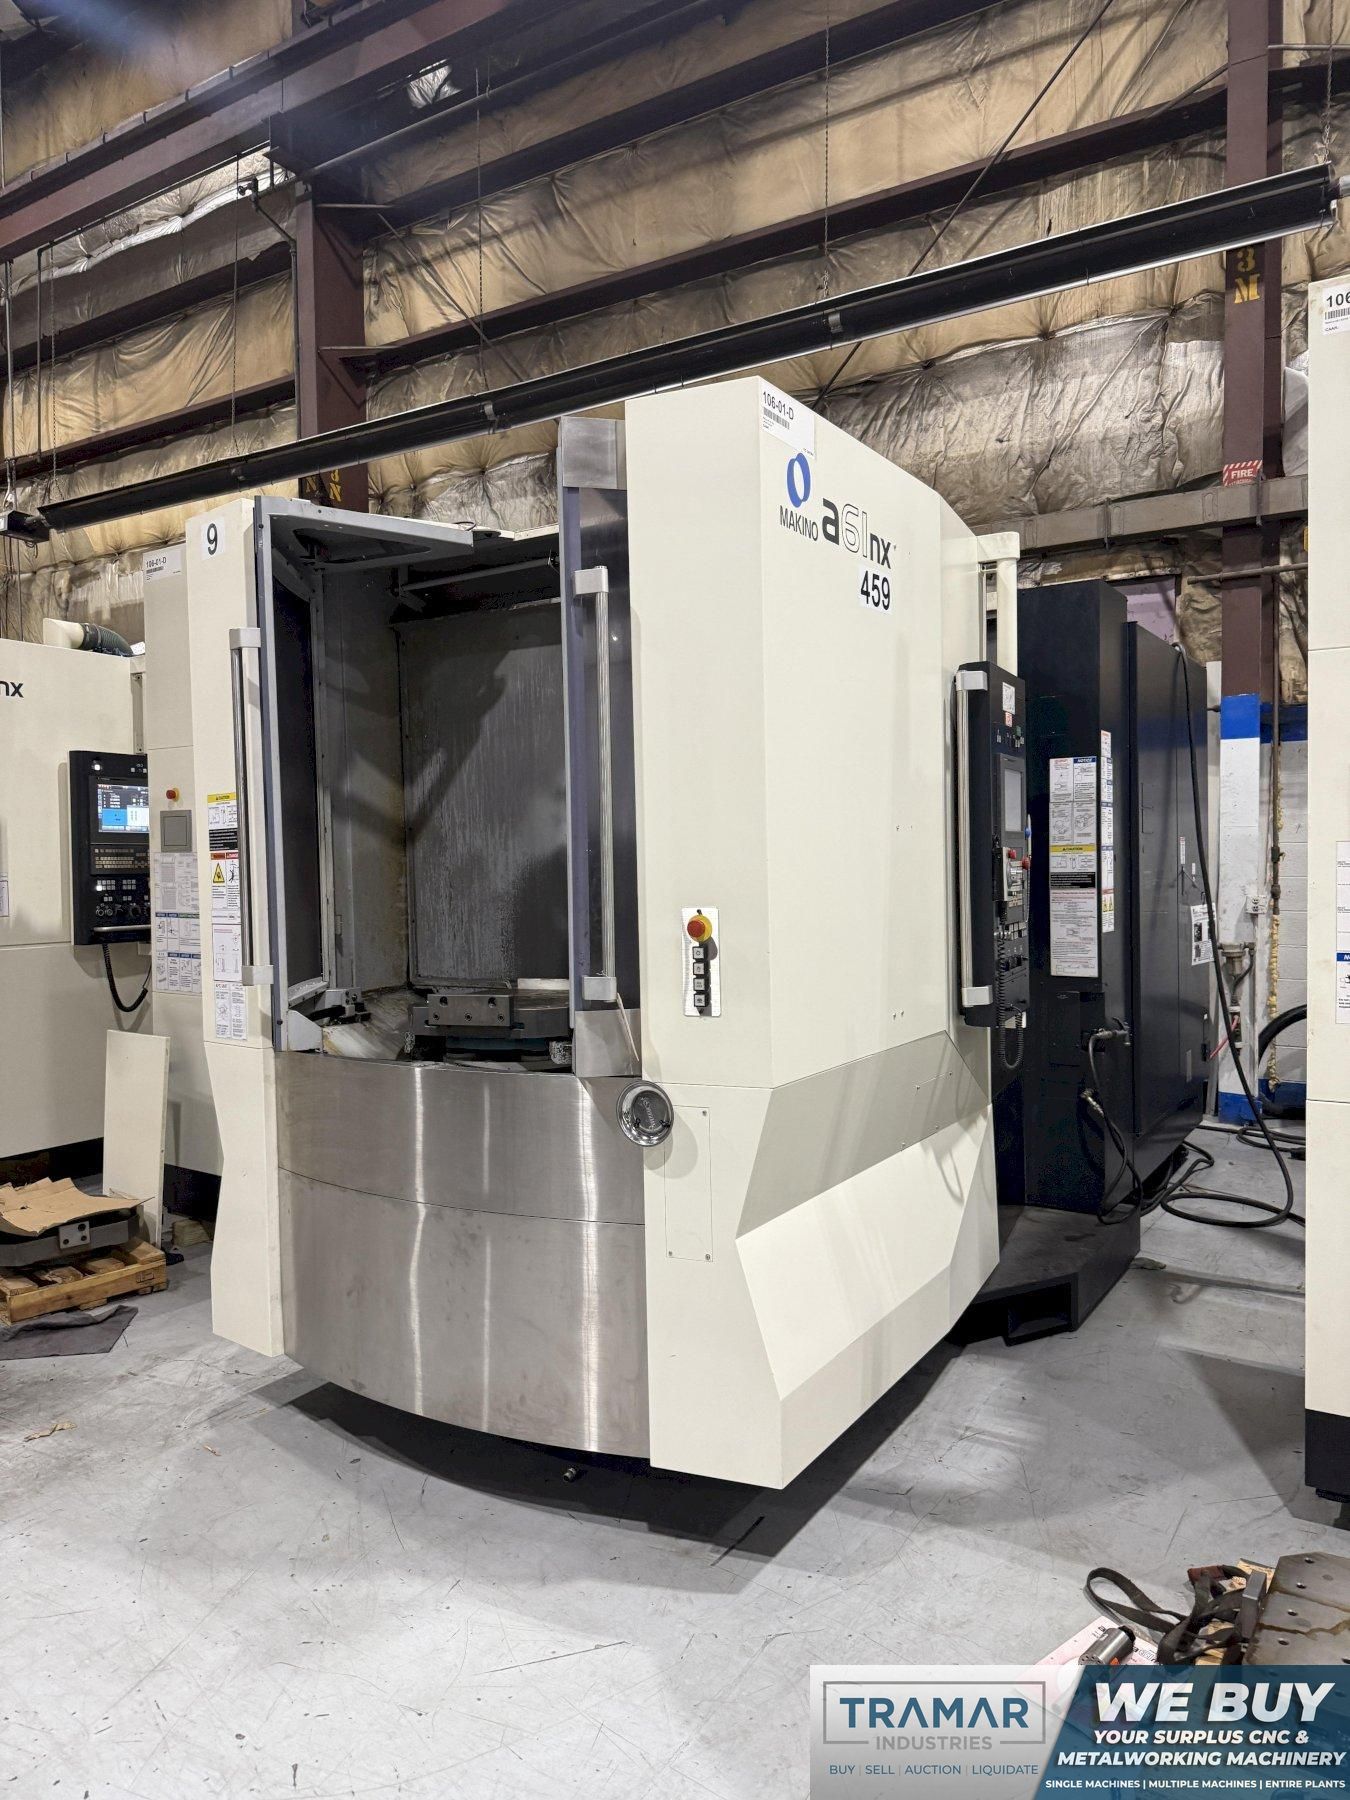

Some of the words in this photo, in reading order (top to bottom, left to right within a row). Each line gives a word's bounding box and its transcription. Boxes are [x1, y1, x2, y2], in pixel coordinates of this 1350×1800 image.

[1237, 246, 1256, 272] 3
[1234, 273, 1261, 304] M
[763, 391, 794, 420] 106-01-D
[1231, 468, 1254, 479] FIRE
[206, 522, 218, 556] 9
[779, 505, 819, 542] MAKINO
[822, 497, 891, 569] a61nx
[860, 570, 890, 611] 459
